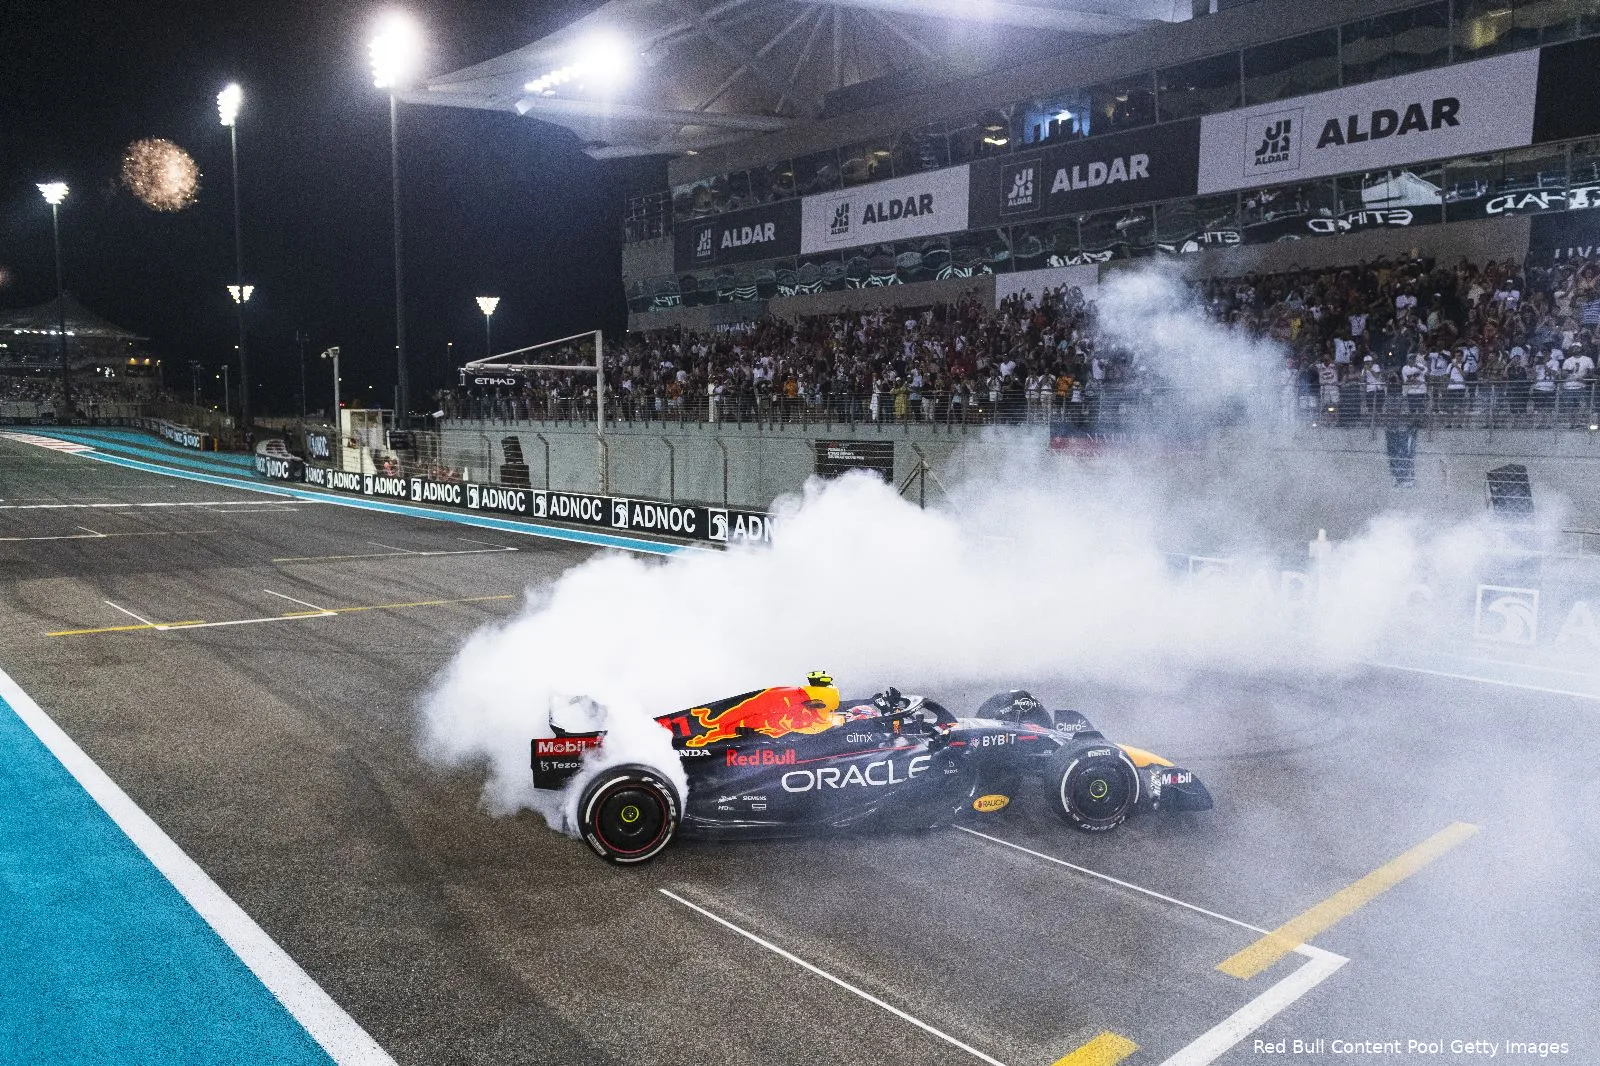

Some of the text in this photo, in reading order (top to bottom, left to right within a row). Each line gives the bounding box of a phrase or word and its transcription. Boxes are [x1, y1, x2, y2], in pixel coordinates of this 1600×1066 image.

[1316, 97, 1461, 149] ALDAR
[1254, 153, 1289, 166] ALDAR
[1051, 153, 1150, 193] ALDAR
[862, 193, 934, 225] ALDAR
[1008, 197, 1032, 206] ALDAR
[721, 222, 775, 249] ALDAR
[830, 227, 849, 236] ALDAR
[475, 377, 516, 386] ETIHAD
[334, 472, 360, 490] ADNOC
[374, 477, 406, 496] ADNOC
[424, 482, 461, 504] ADNOC
[481, 488, 526, 512] ADNOC
[550, 495, 602, 521] ADNOC
[632, 504, 696, 533] ADNOC
[733, 514, 777, 542] ADN
[1056, 722, 1082, 732] Claro
[846, 731, 873, 743] citrix
[982, 733, 1016, 747] BYBIT
[538, 740, 587, 753] Mobil
[680, 749, 711, 757] NDA
[726, 749, 796, 767] Red Bull
[781, 755, 931, 793] ORACLE
[1161, 773, 1192, 785] Mobil
[983, 799, 1006, 808] RAUCH
